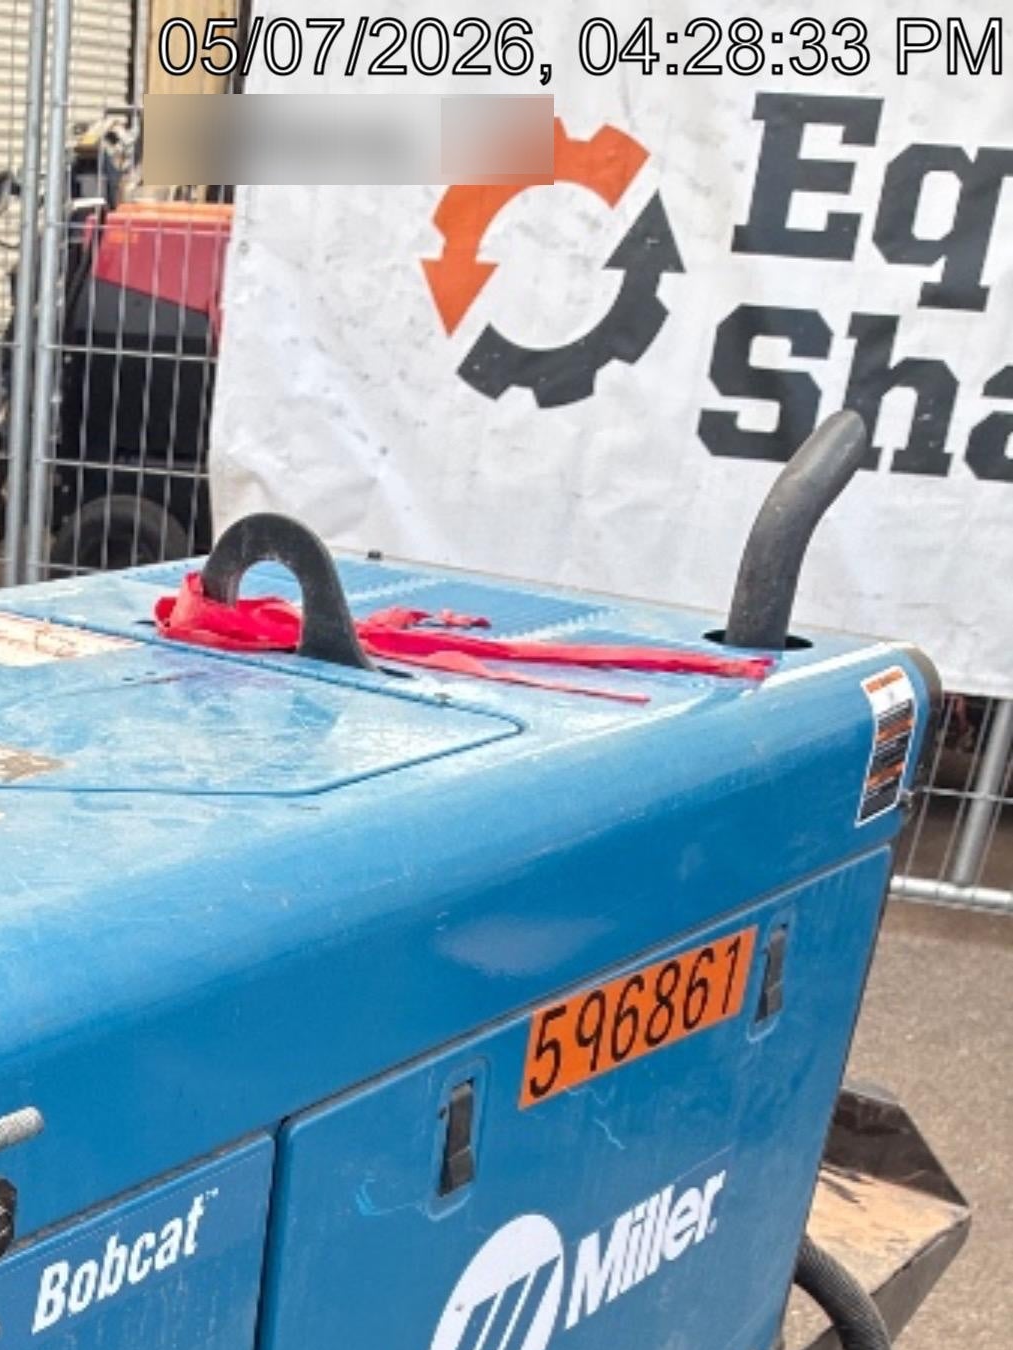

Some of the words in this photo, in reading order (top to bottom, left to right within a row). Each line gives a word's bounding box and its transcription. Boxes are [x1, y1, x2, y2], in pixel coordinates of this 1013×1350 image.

[731, 92, 1013, 312] Eq
[530, 935, 742, 1098] 596861
[564, 1169, 727, 1330] Miller
